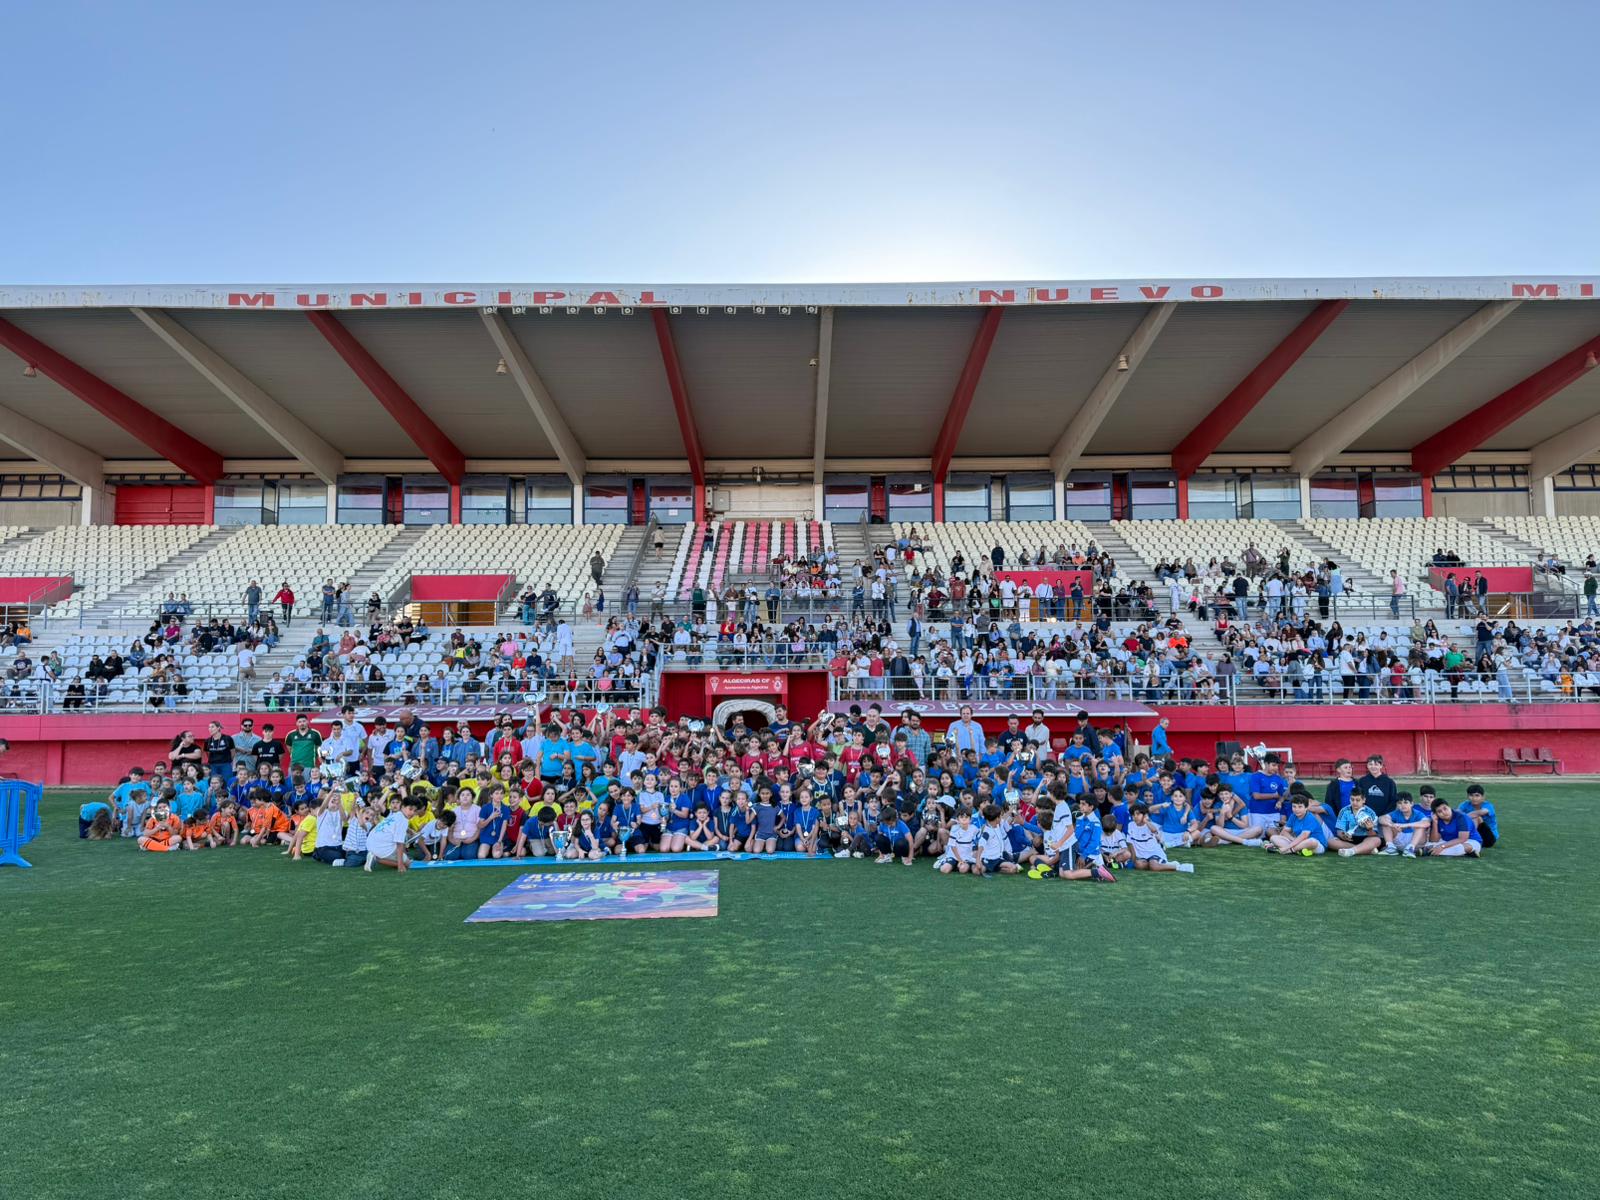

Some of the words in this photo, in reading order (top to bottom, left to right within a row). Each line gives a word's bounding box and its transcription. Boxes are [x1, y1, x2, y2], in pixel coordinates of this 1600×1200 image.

[229, 291, 667, 307] MUNICIPAL
[979, 285, 1223, 303] NUEVO
[1511, 283, 1593, 297] MI
